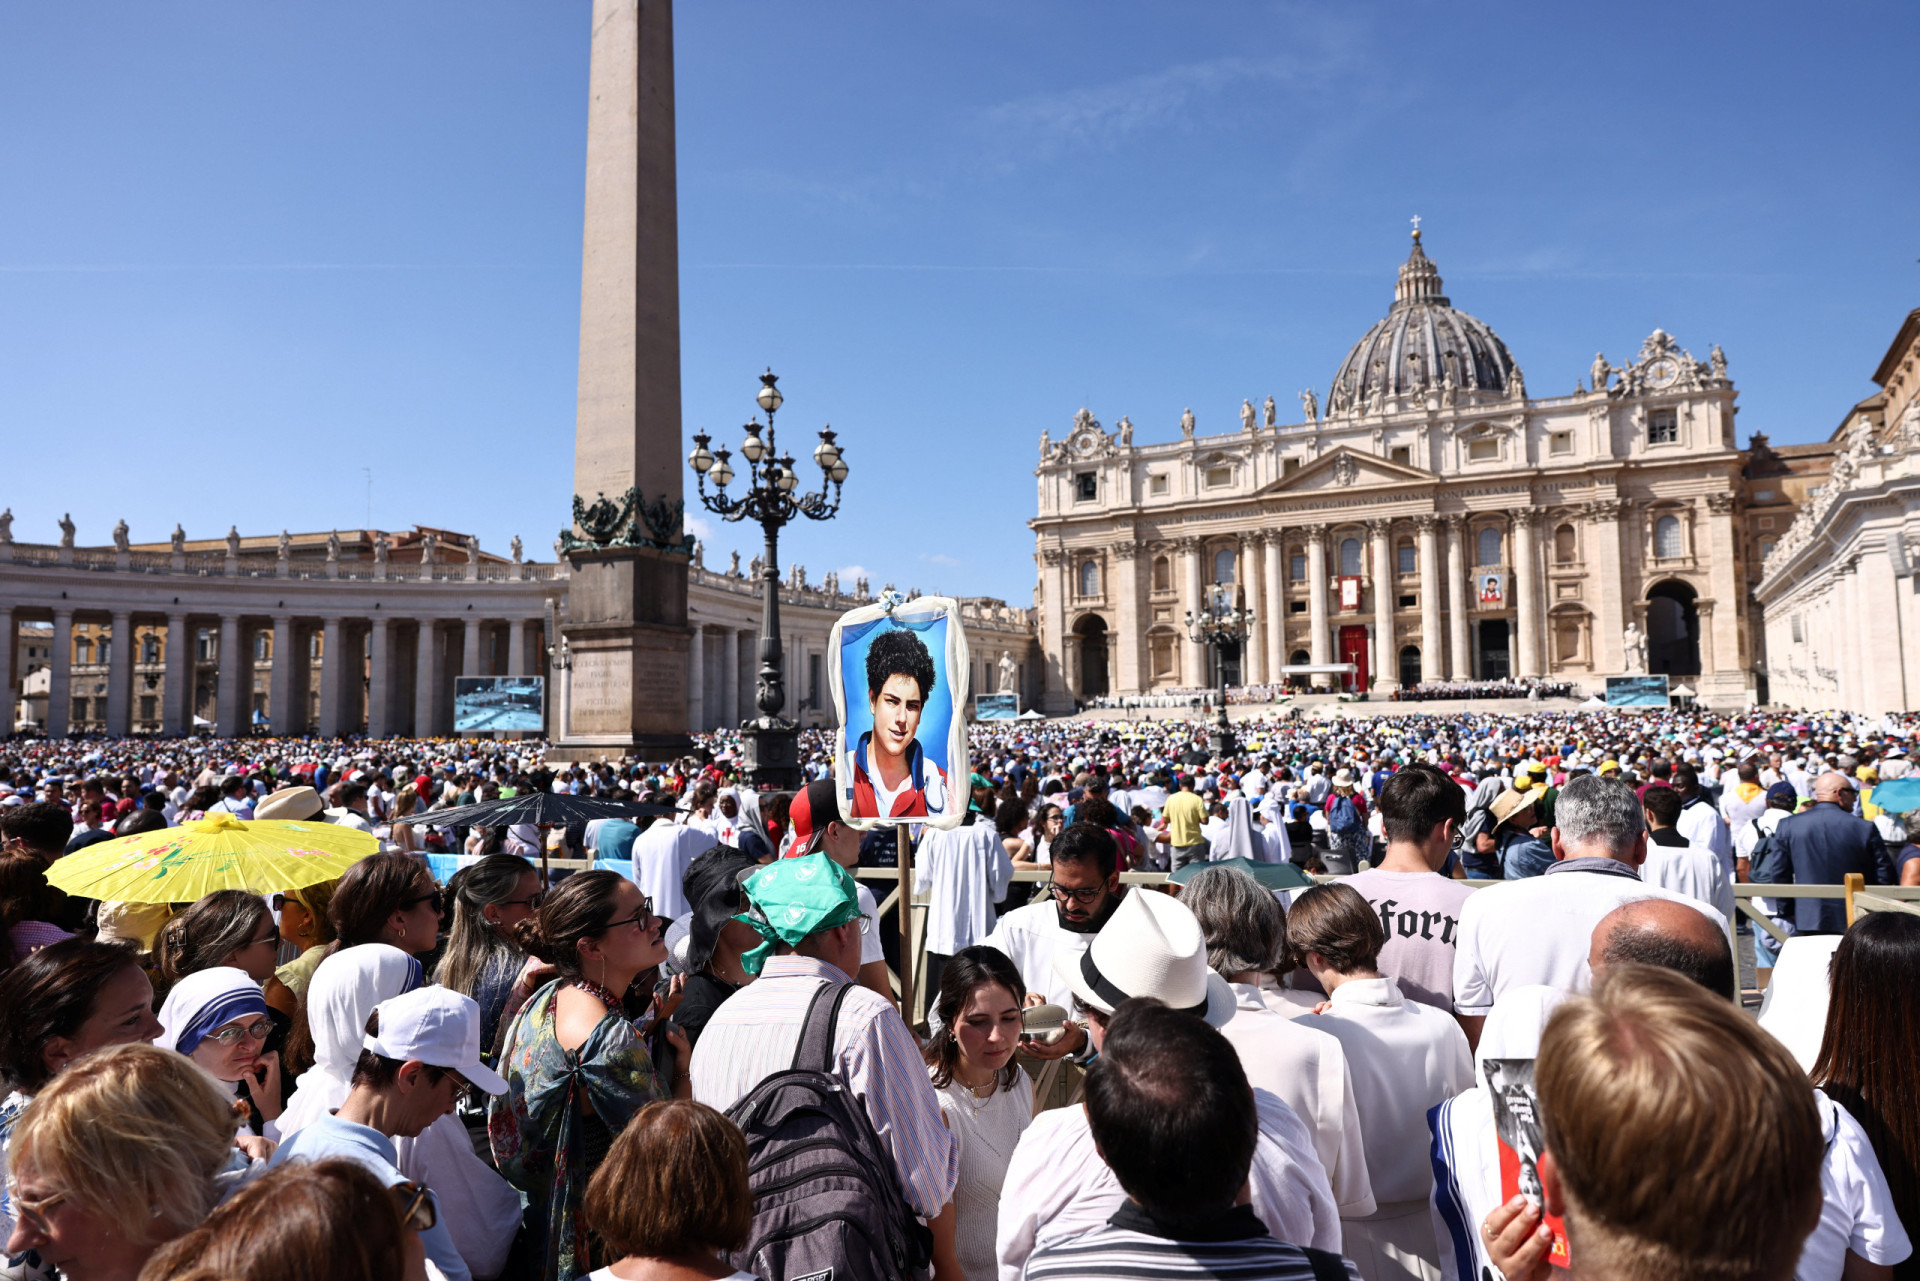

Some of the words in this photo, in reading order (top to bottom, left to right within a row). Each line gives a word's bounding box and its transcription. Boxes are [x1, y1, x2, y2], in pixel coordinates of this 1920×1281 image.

[1377, 493, 1432, 503] ROMANVS
[796, 842, 807, 855] 16
[1369, 899, 1458, 949] forn
